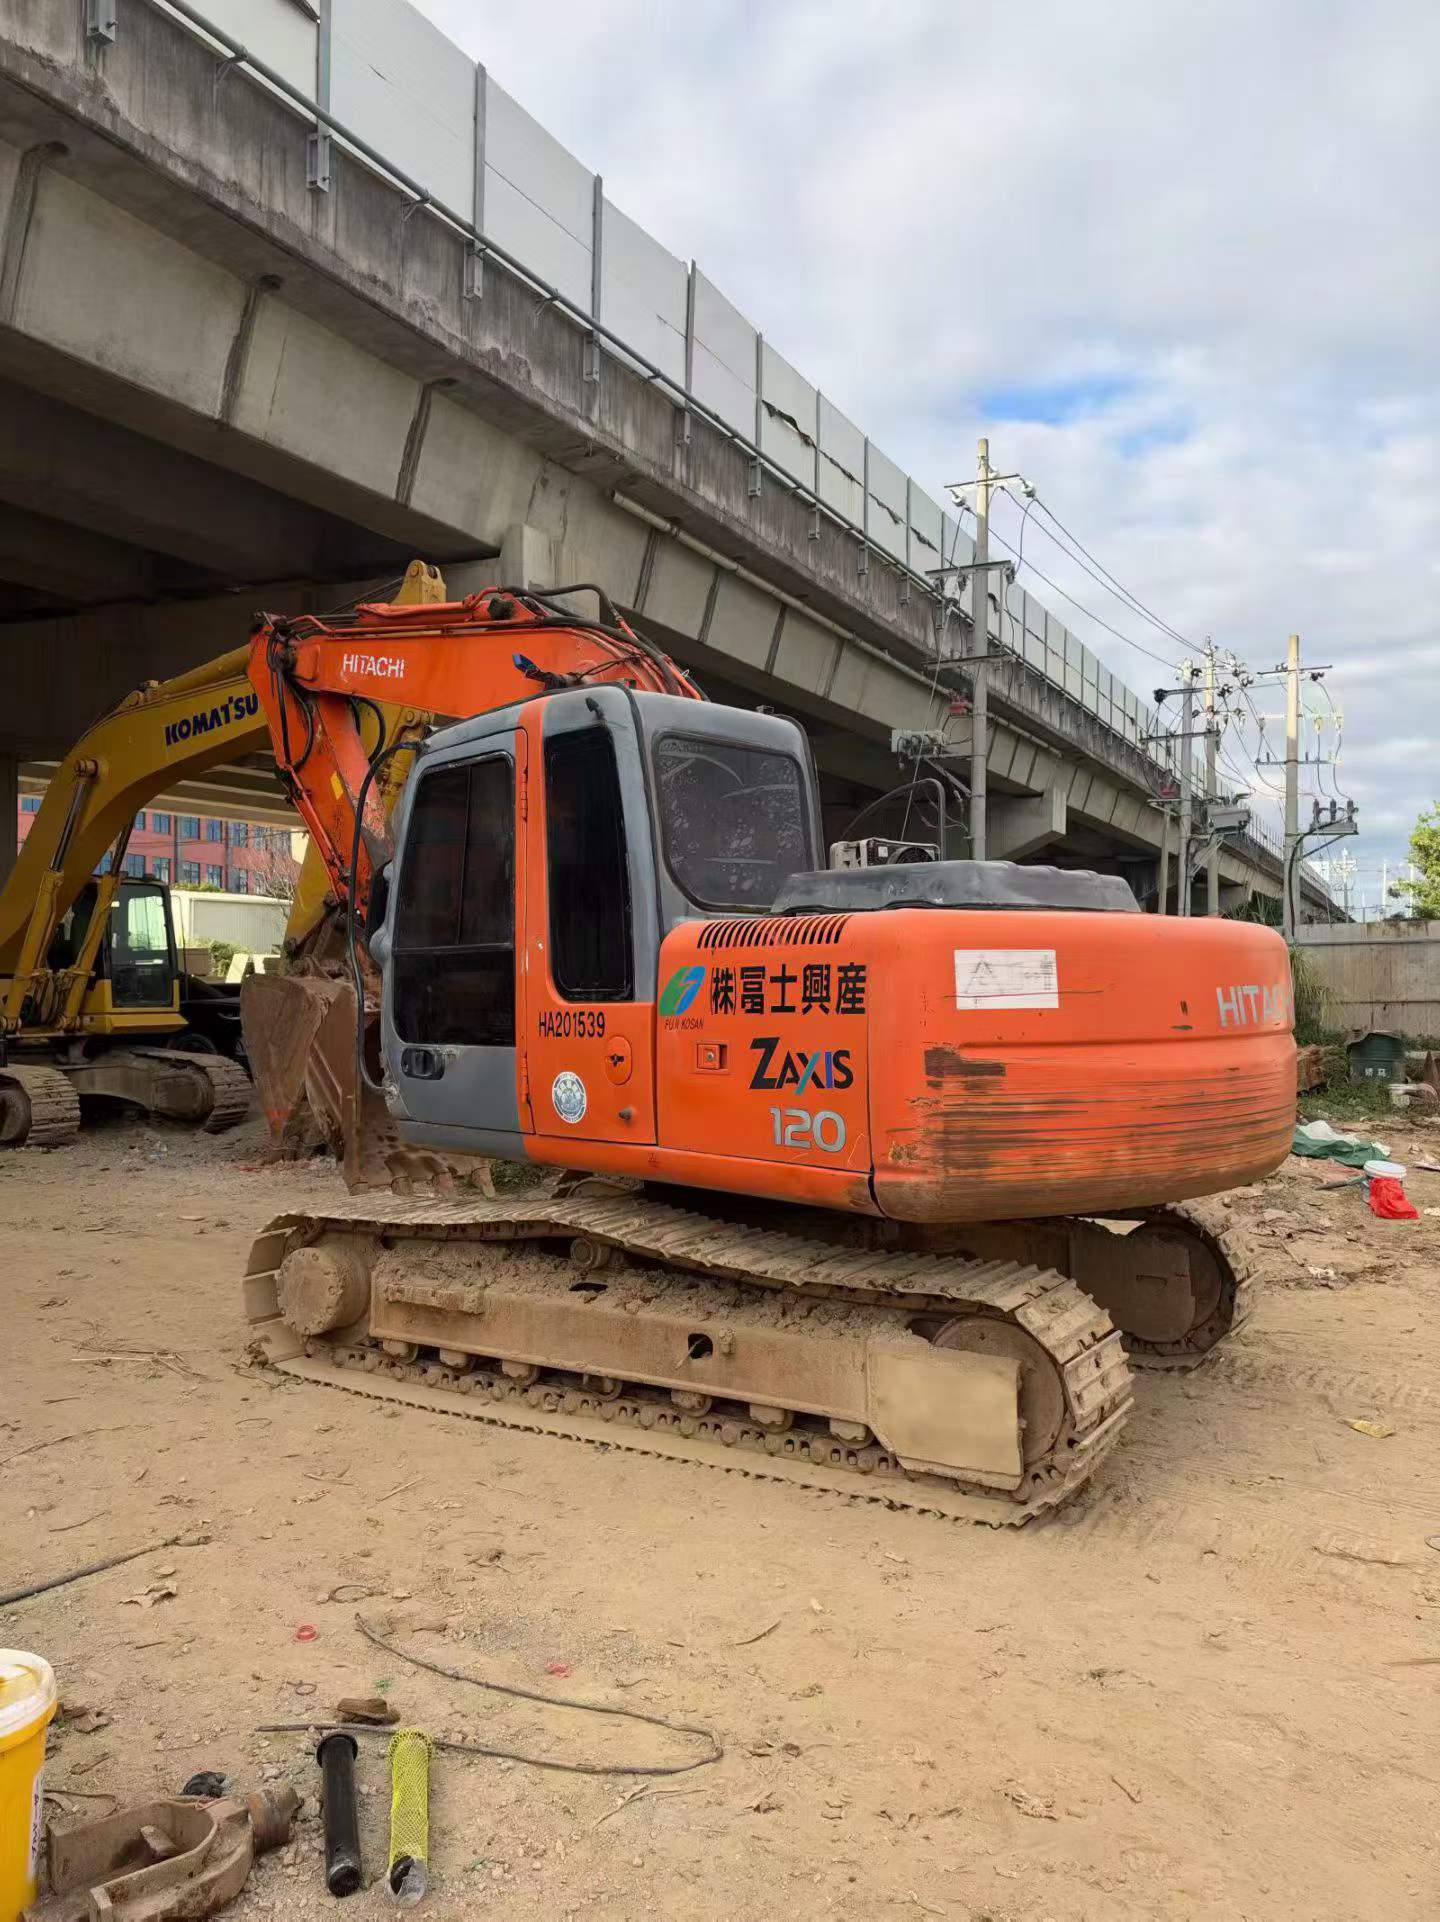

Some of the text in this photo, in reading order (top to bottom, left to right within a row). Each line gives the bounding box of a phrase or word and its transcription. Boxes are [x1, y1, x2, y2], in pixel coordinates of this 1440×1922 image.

[342, 653, 405, 678] HITACHI
[164, 693, 259, 746] KOMATSU
[538, 1010, 605, 1038] HA201539
[749, 1036, 854, 1095] ZAXIS
[769, 1106, 847, 1152] 120
